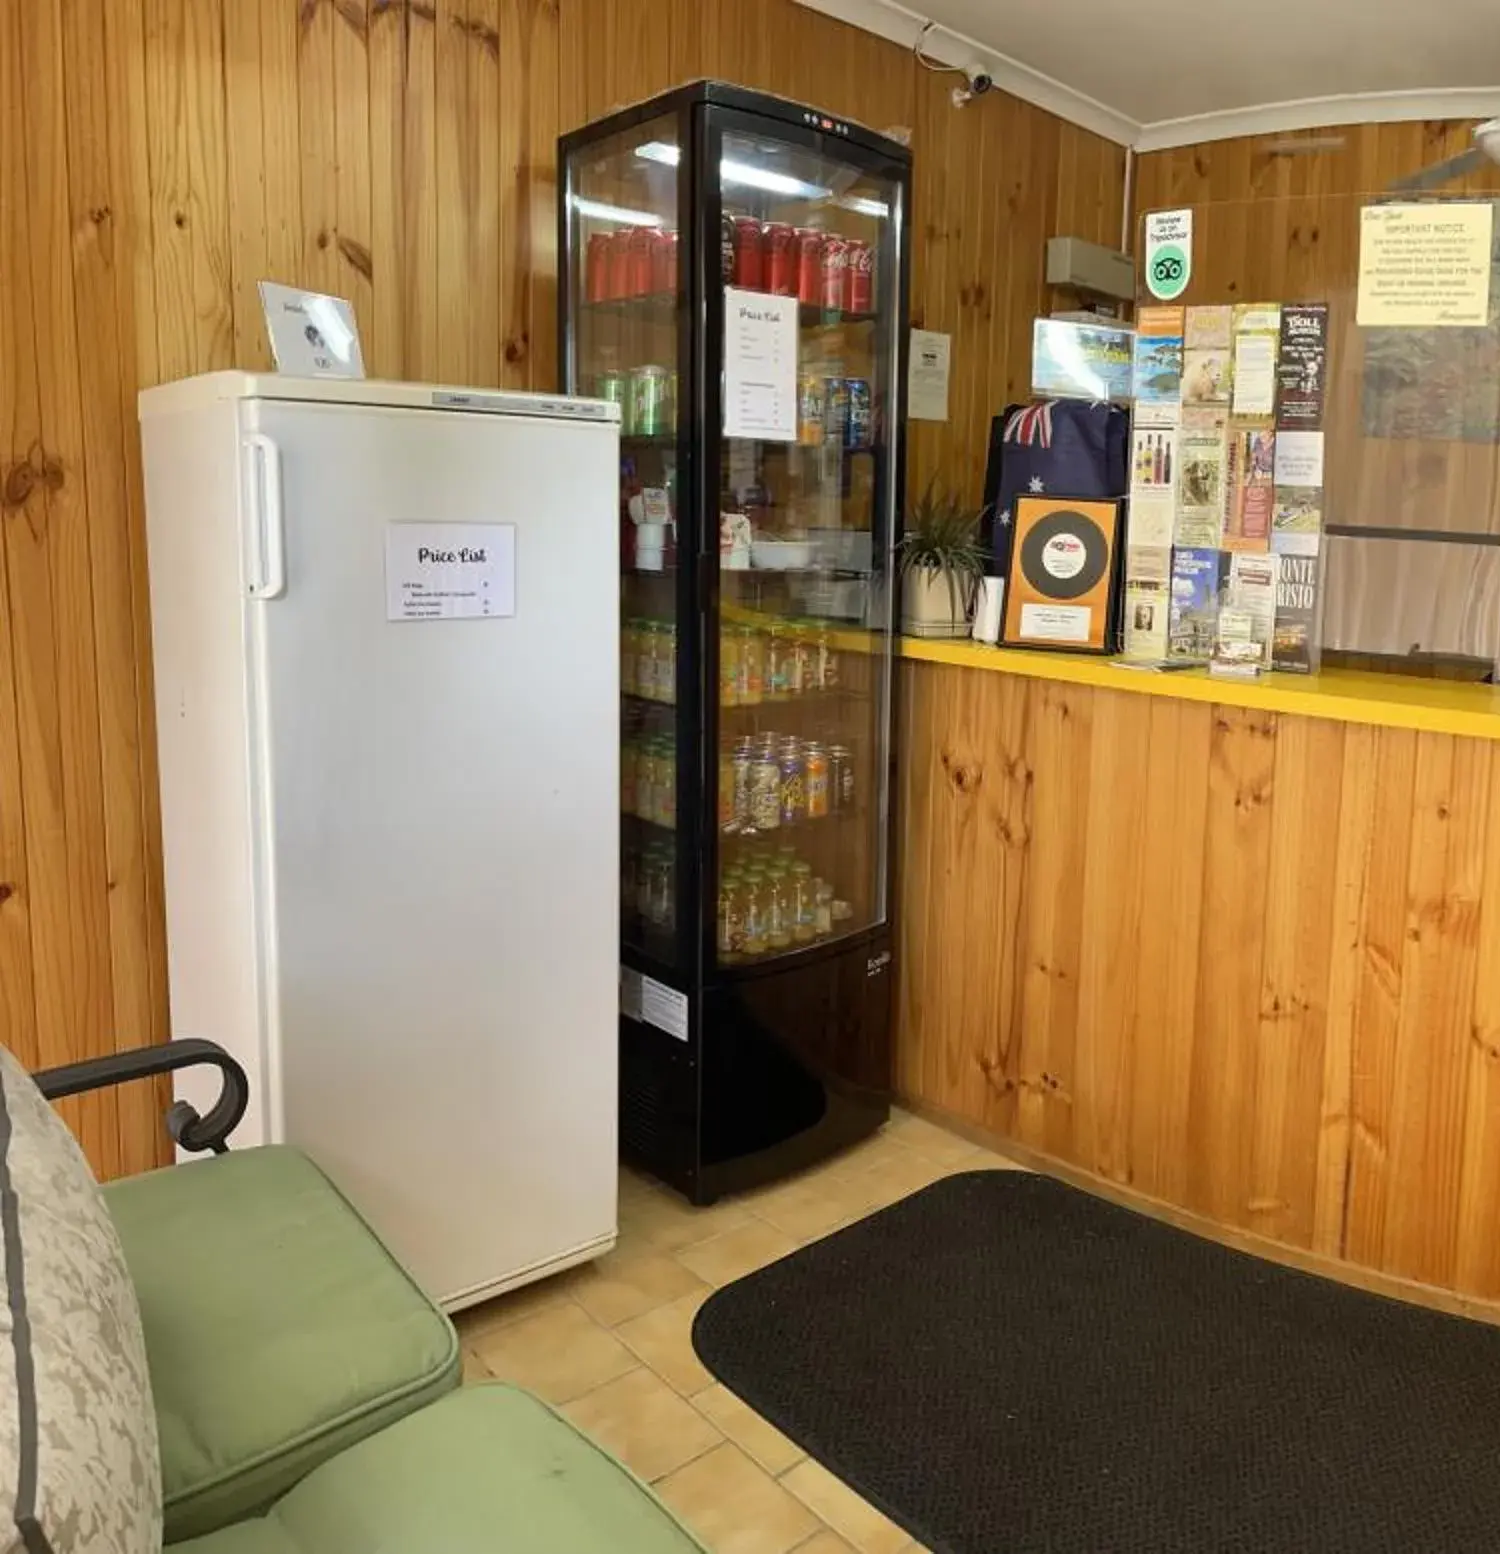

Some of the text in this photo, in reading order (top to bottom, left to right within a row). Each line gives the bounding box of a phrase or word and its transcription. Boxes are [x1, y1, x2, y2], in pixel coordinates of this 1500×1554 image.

[1434, 223, 1465, 232] NOTICE
[418, 547, 487, 564] Price List
[1276, 583, 1314, 609] RISTO
